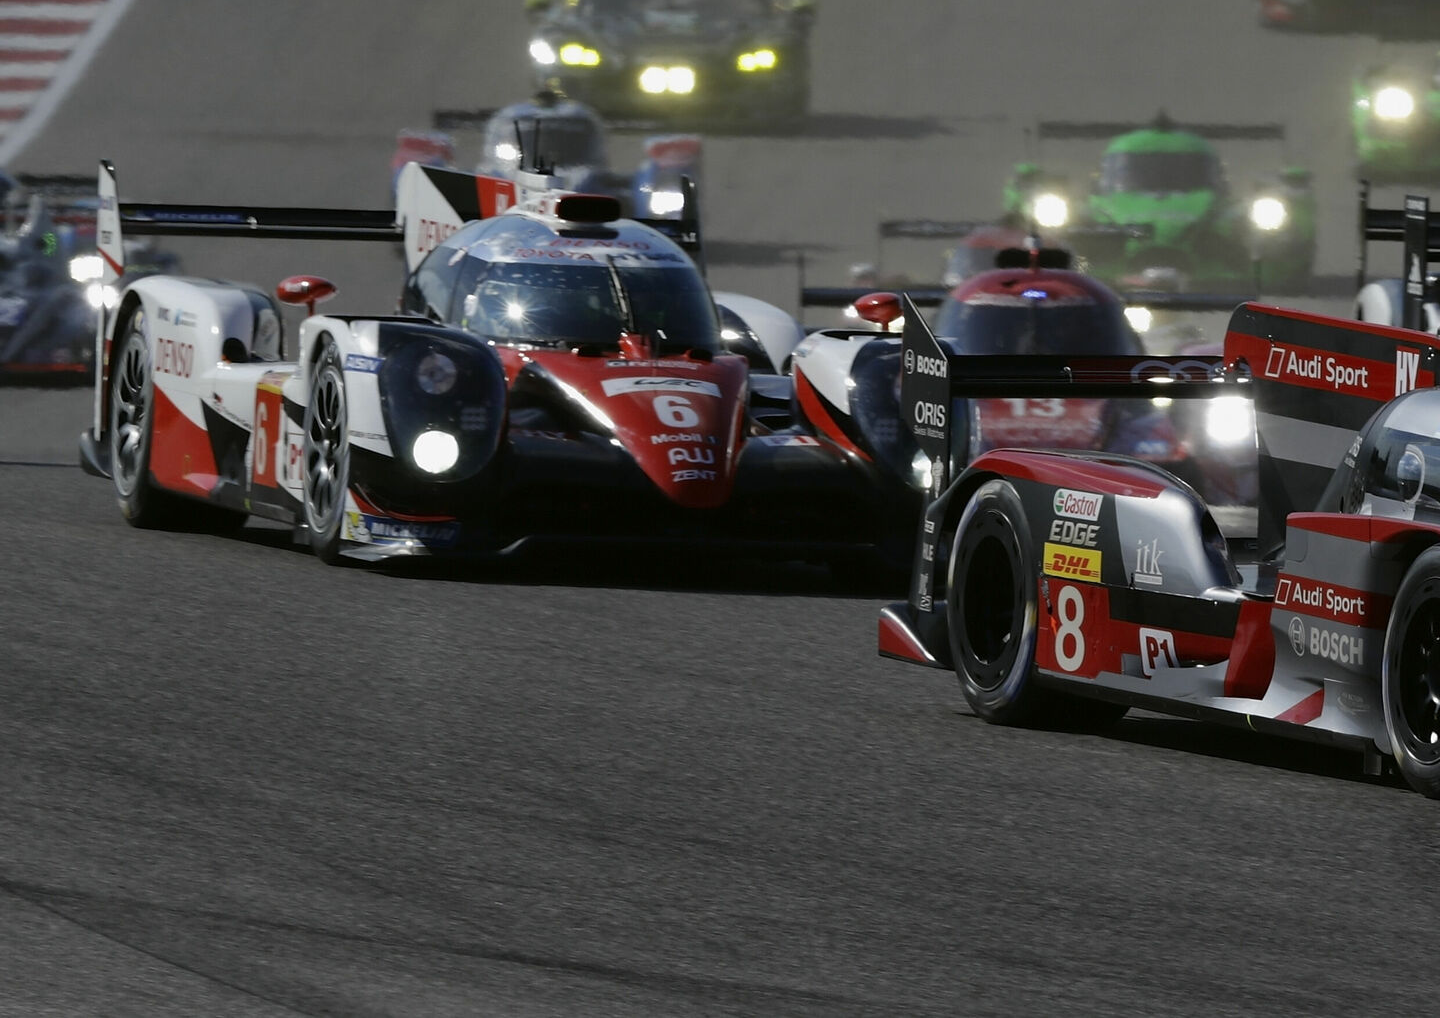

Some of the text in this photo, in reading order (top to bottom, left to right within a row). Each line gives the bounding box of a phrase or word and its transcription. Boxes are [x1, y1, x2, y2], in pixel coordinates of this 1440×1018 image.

[155, 337, 195, 379] DENSO
[917, 354, 948, 379] BOSCH
[1286, 350, 1369, 389] Audi Sport
[1395, 349, 1420, 397] HY
[652, 395, 700, 429] 6
[914, 400, 947, 428] ORIS
[255, 401, 269, 476] 6
[650, 432, 703, 446] Mobil
[670, 469, 718, 483] ZENT
[1064, 493, 1099, 517] Castrol
[1049, 519, 1101, 547] EDGE
[1052, 553, 1092, 576] DHL
[1134, 538, 1165, 575] itk
[1292, 582, 1366, 616] Audi Sport
[1055, 585, 1086, 673] 8
[1309, 626, 1364, 666] BOSCH
[1145, 635, 1175, 671] P1
